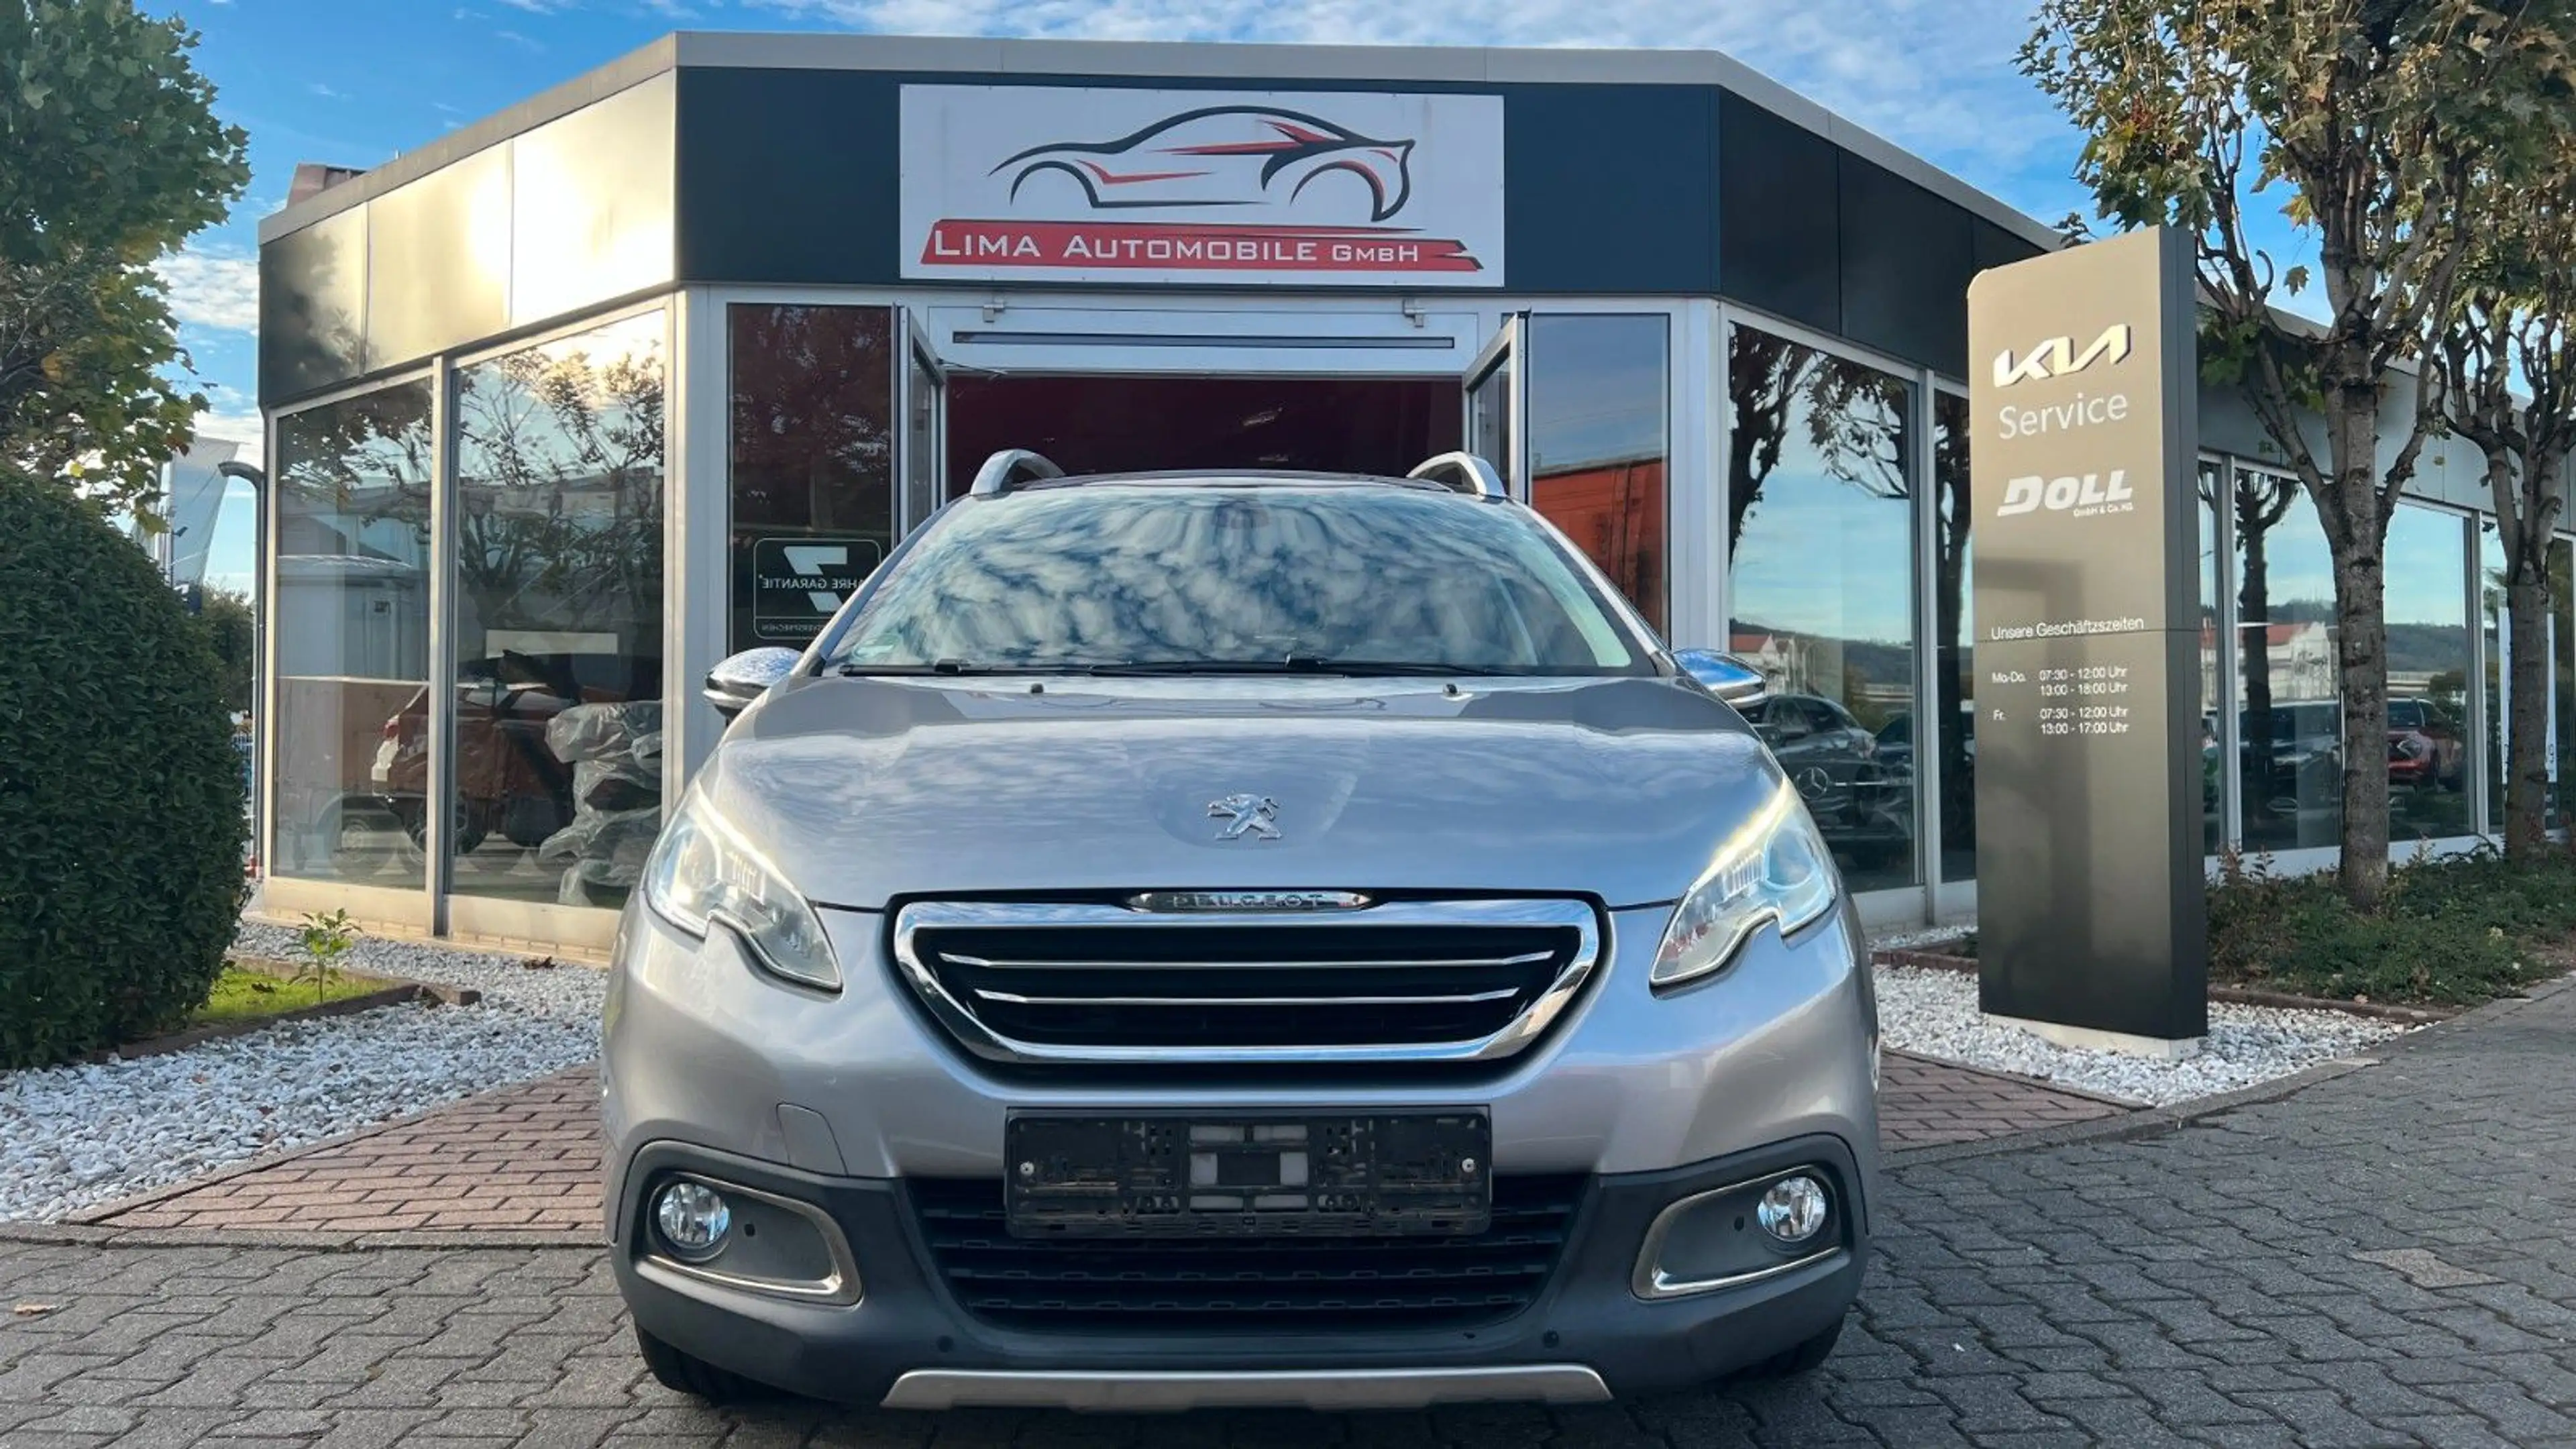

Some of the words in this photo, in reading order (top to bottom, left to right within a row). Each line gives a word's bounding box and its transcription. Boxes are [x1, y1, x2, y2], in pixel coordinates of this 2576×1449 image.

[934, 230, 1041, 258] LIMA
[1062, 235, 1318, 261] AUTOMOBILE
[1993, 324, 2131, 387] KIA
[1999, 392, 2128, 439] Service
[1997, 470, 2133, 517] DOLL
[1991, 626, 2033, 639] Unsere
[2039, 669, 2068, 681] 07:30
[2078, 668, 2105, 680] 12:00
[2108, 665, 2127, 678] Uhr
[2108, 680, 2127, 694] Uhr
[2079, 706, 2106, 718] 12:00
[2108, 704, 2128, 717] Uhr
[2041, 722, 2068, 735] 13:00
[2079, 720, 2107, 733] 17:00
[2108, 718, 2129, 733] Uhr
